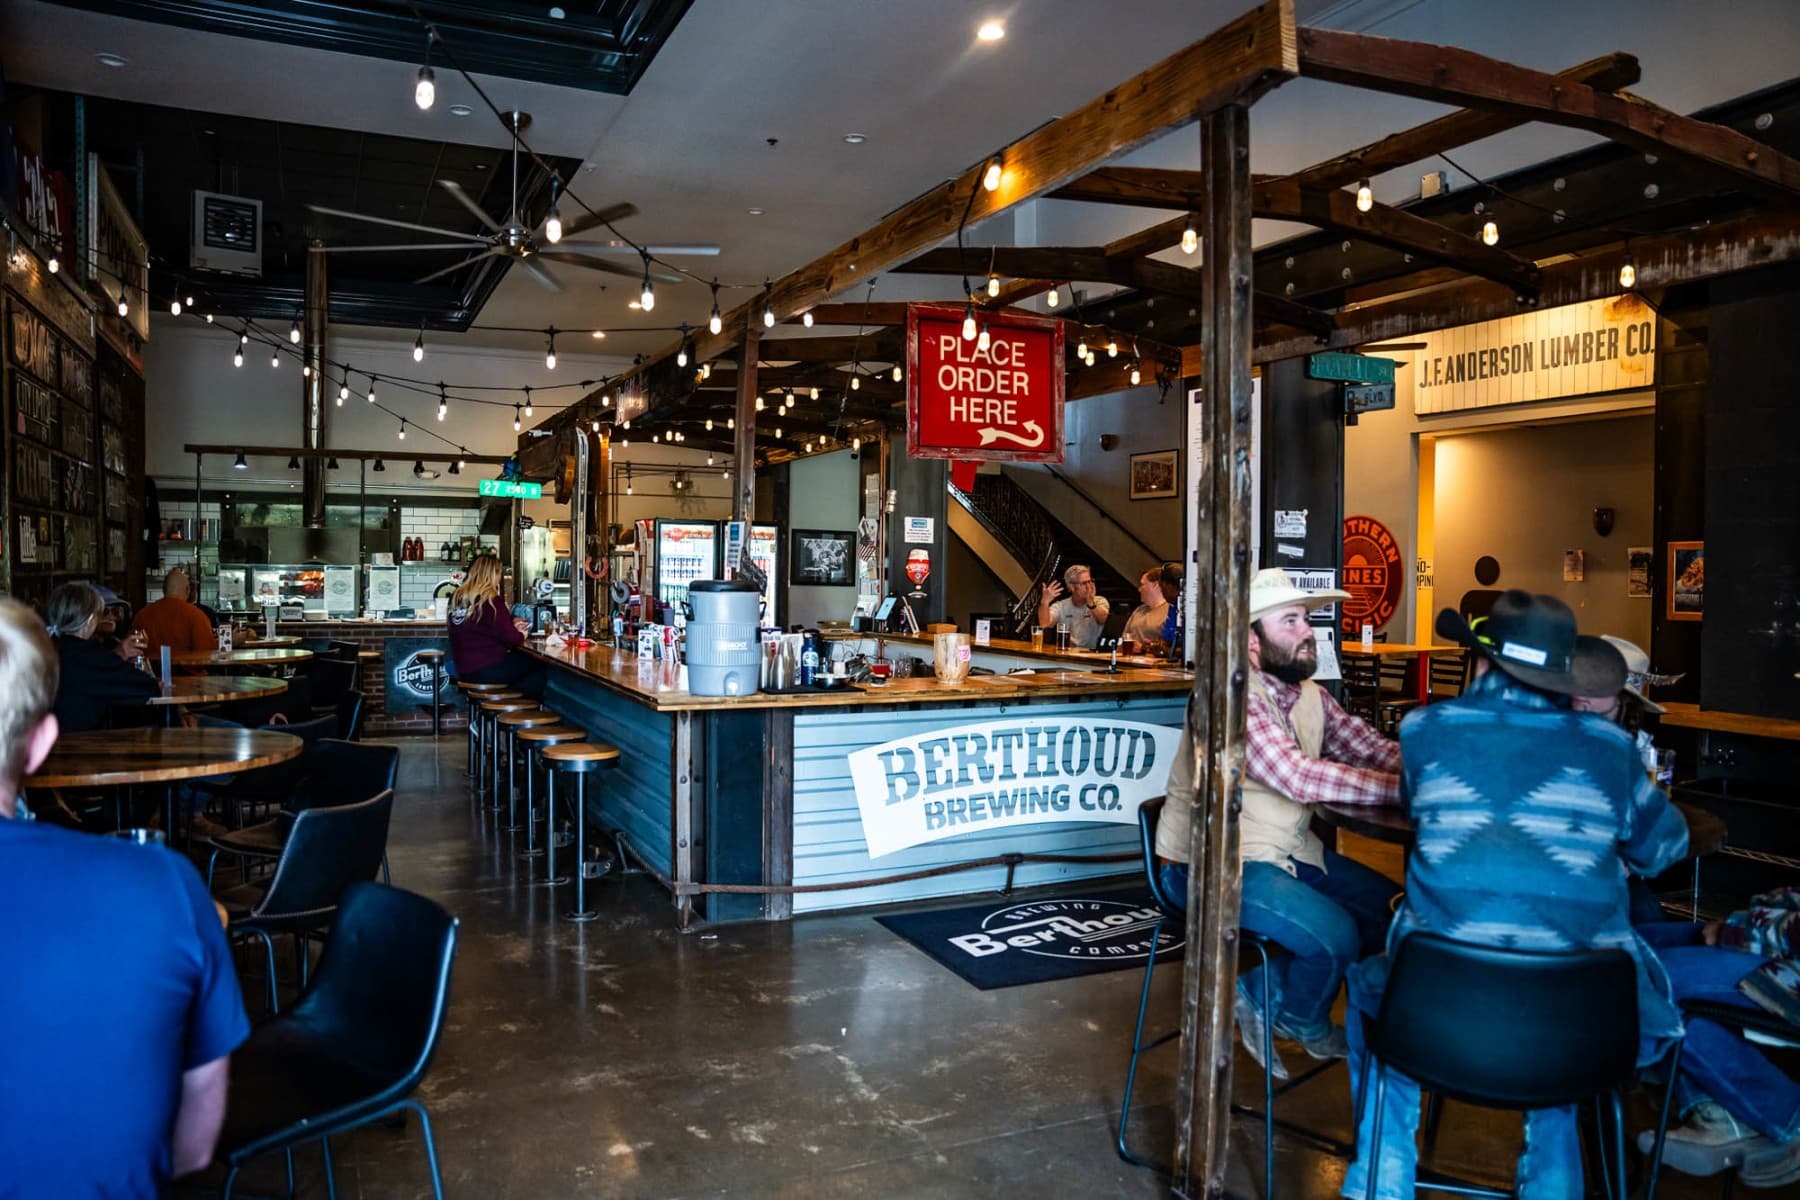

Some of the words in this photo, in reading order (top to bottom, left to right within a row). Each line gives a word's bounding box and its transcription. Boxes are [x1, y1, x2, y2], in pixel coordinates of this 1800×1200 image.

[939, 335, 1026, 367] PLACE
[1540, 328, 1619, 370] LUMBER
[1625, 321, 1655, 358] CO.
[938, 365, 1029, 396] ORDER
[950, 396, 1018, 426] HERE
[484, 481, 500, 495] 27
[1343, 569, 1383, 584] INES
[878, 725, 1156, 806] BERTHOUD
[924, 783, 1071, 831] BREWING
[1079, 783, 1123, 812] CO.
[948, 905, 1163, 958] Berthou
